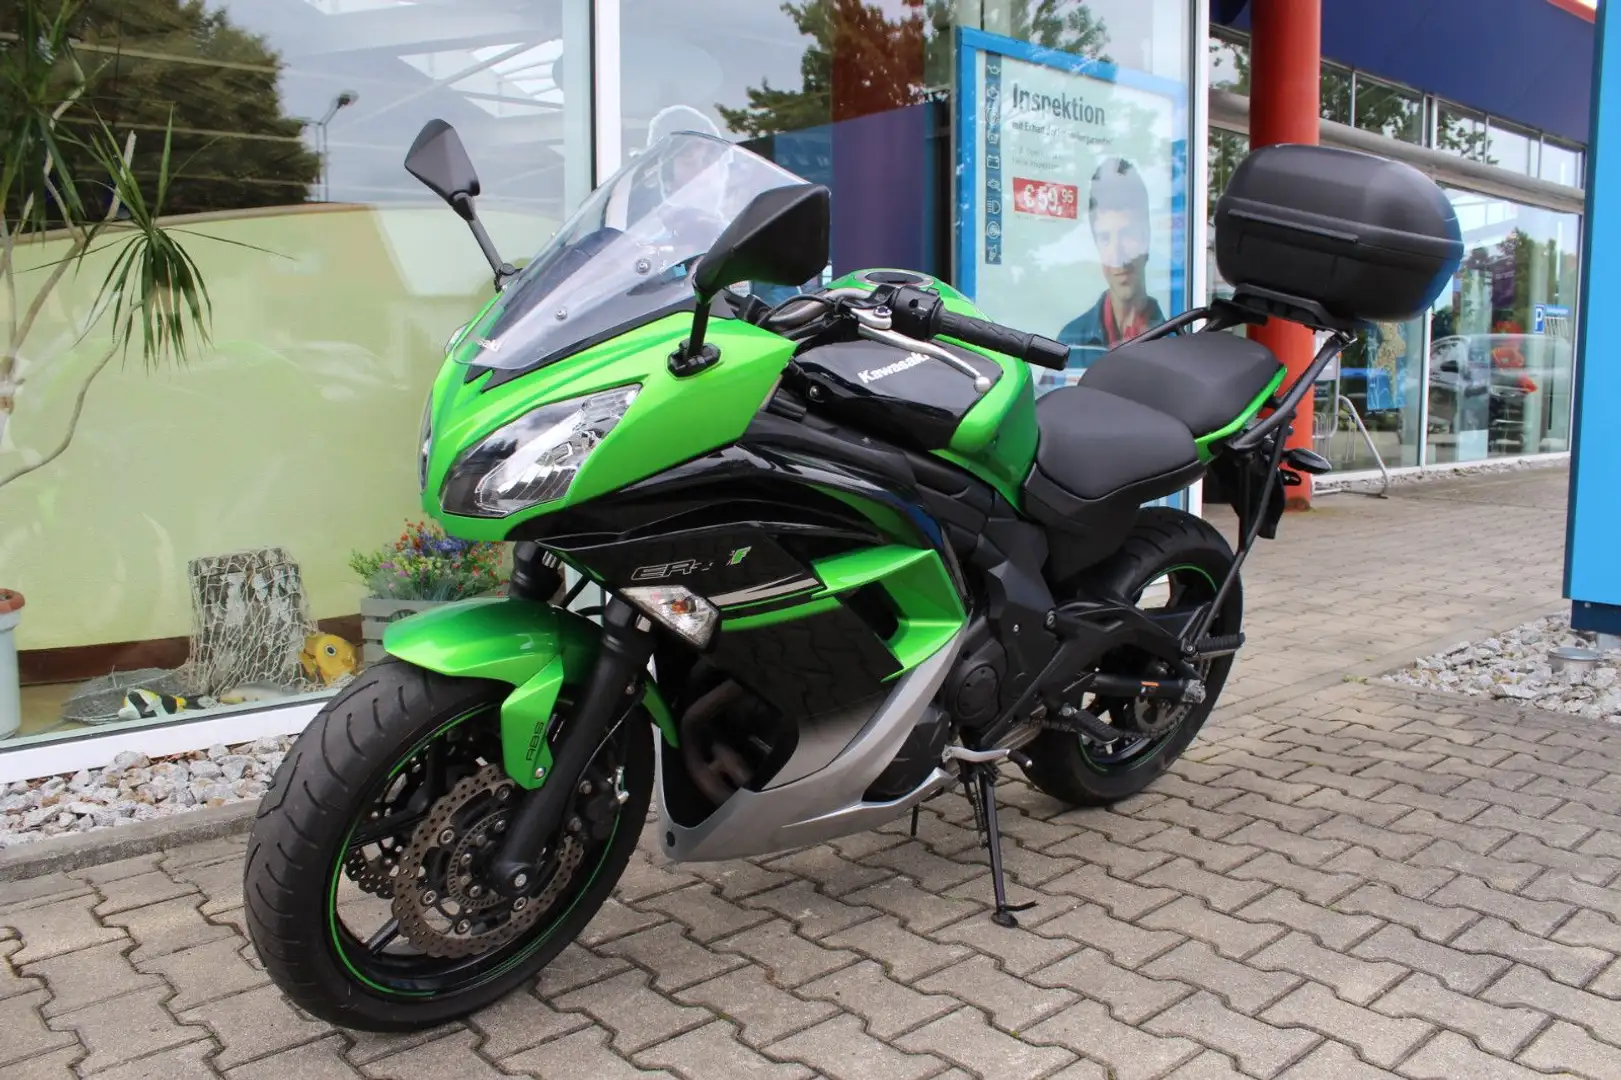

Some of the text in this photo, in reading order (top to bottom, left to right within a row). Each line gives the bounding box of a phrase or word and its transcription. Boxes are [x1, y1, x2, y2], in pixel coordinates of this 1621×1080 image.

[1013, 83, 1105, 126] Inspektion
[1024, 184, 1035, 207] €
[526, 721, 545, 761] ABS
